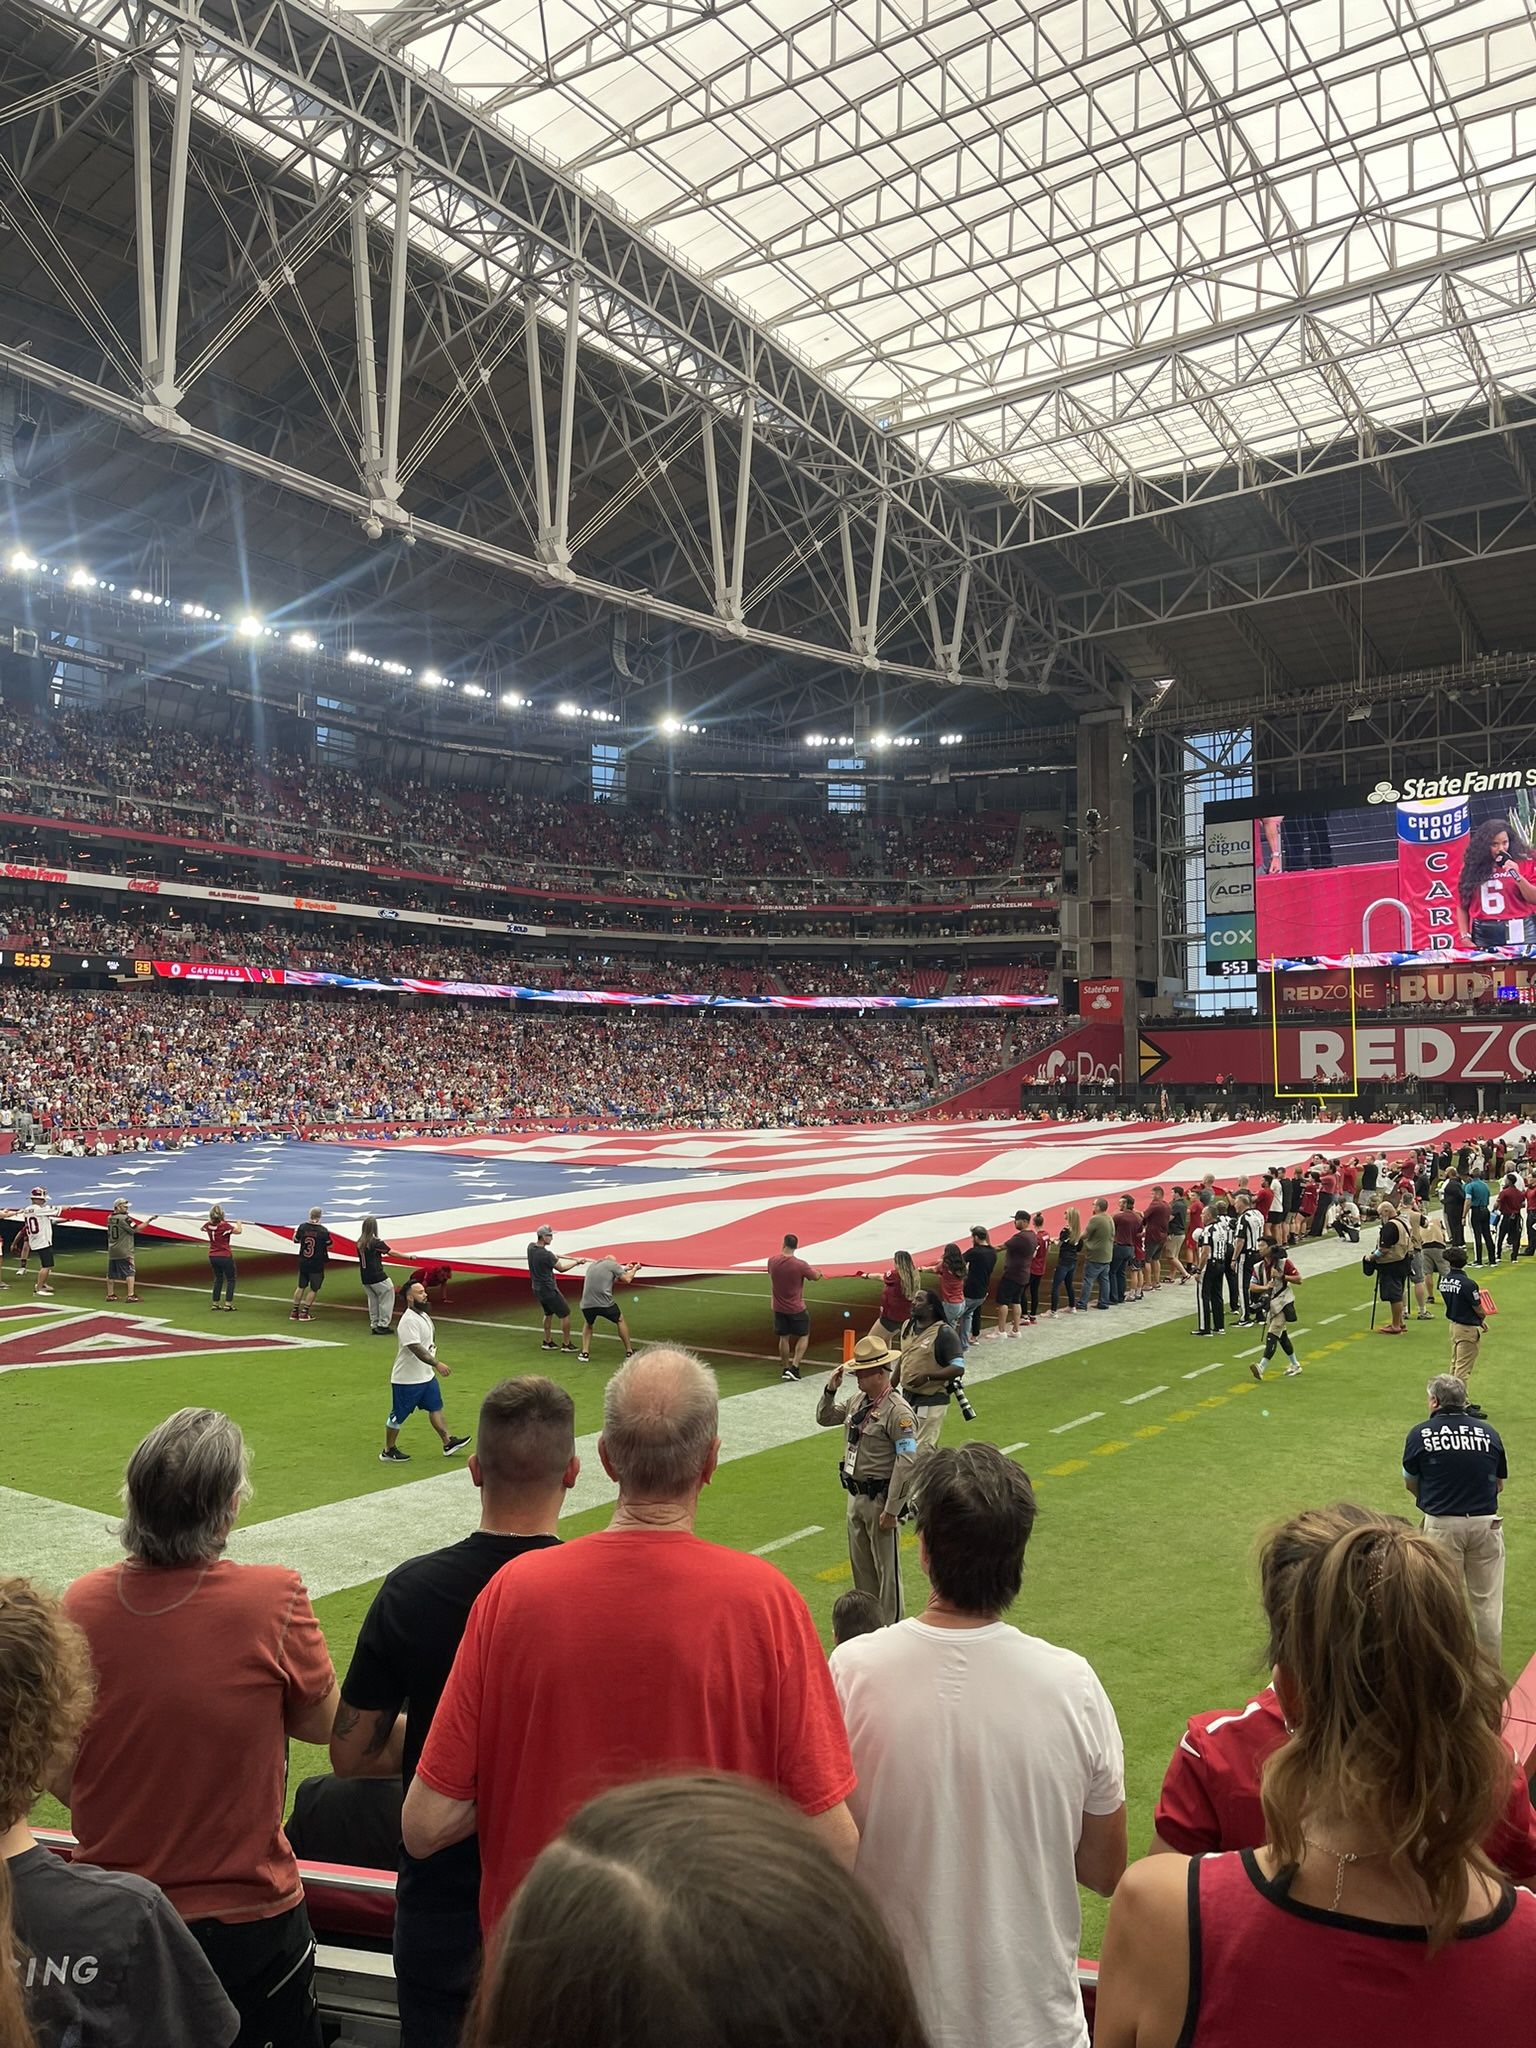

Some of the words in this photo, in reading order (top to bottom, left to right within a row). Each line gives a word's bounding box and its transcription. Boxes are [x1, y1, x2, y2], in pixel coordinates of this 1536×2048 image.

[1408, 806, 1469, 828] CHOOSE
[1419, 823, 1462, 841] LOVE
[1208, 840, 1251, 856] cigna
[321, 858, 344, 868] ROGER
[463, 880, 489, 889] CHARLEY
[490, 883, 507, 891] TRIPPI
[1216, 884, 1252, 896] ACP
[1480, 880, 1506, 915] 6
[1210, 929, 1252, 946] COX
[14, 953, 51, 968] 5:53
[137, 963, 149, 972] 25
[1221, 961, 1248, 974] 5:53
[191, 966, 240, 976] CARDINALS
[1282, 983, 1375, 1001] REDZONE
[1400, 973, 1486, 1002] BUD
[304, 1237, 316, 1258] 3
[1420, 1425, 1490, 1438] S.A.F.E.
[1423, 1435, 1491, 1452] SECURITY
[9, 1955, 99, 1987] ING
